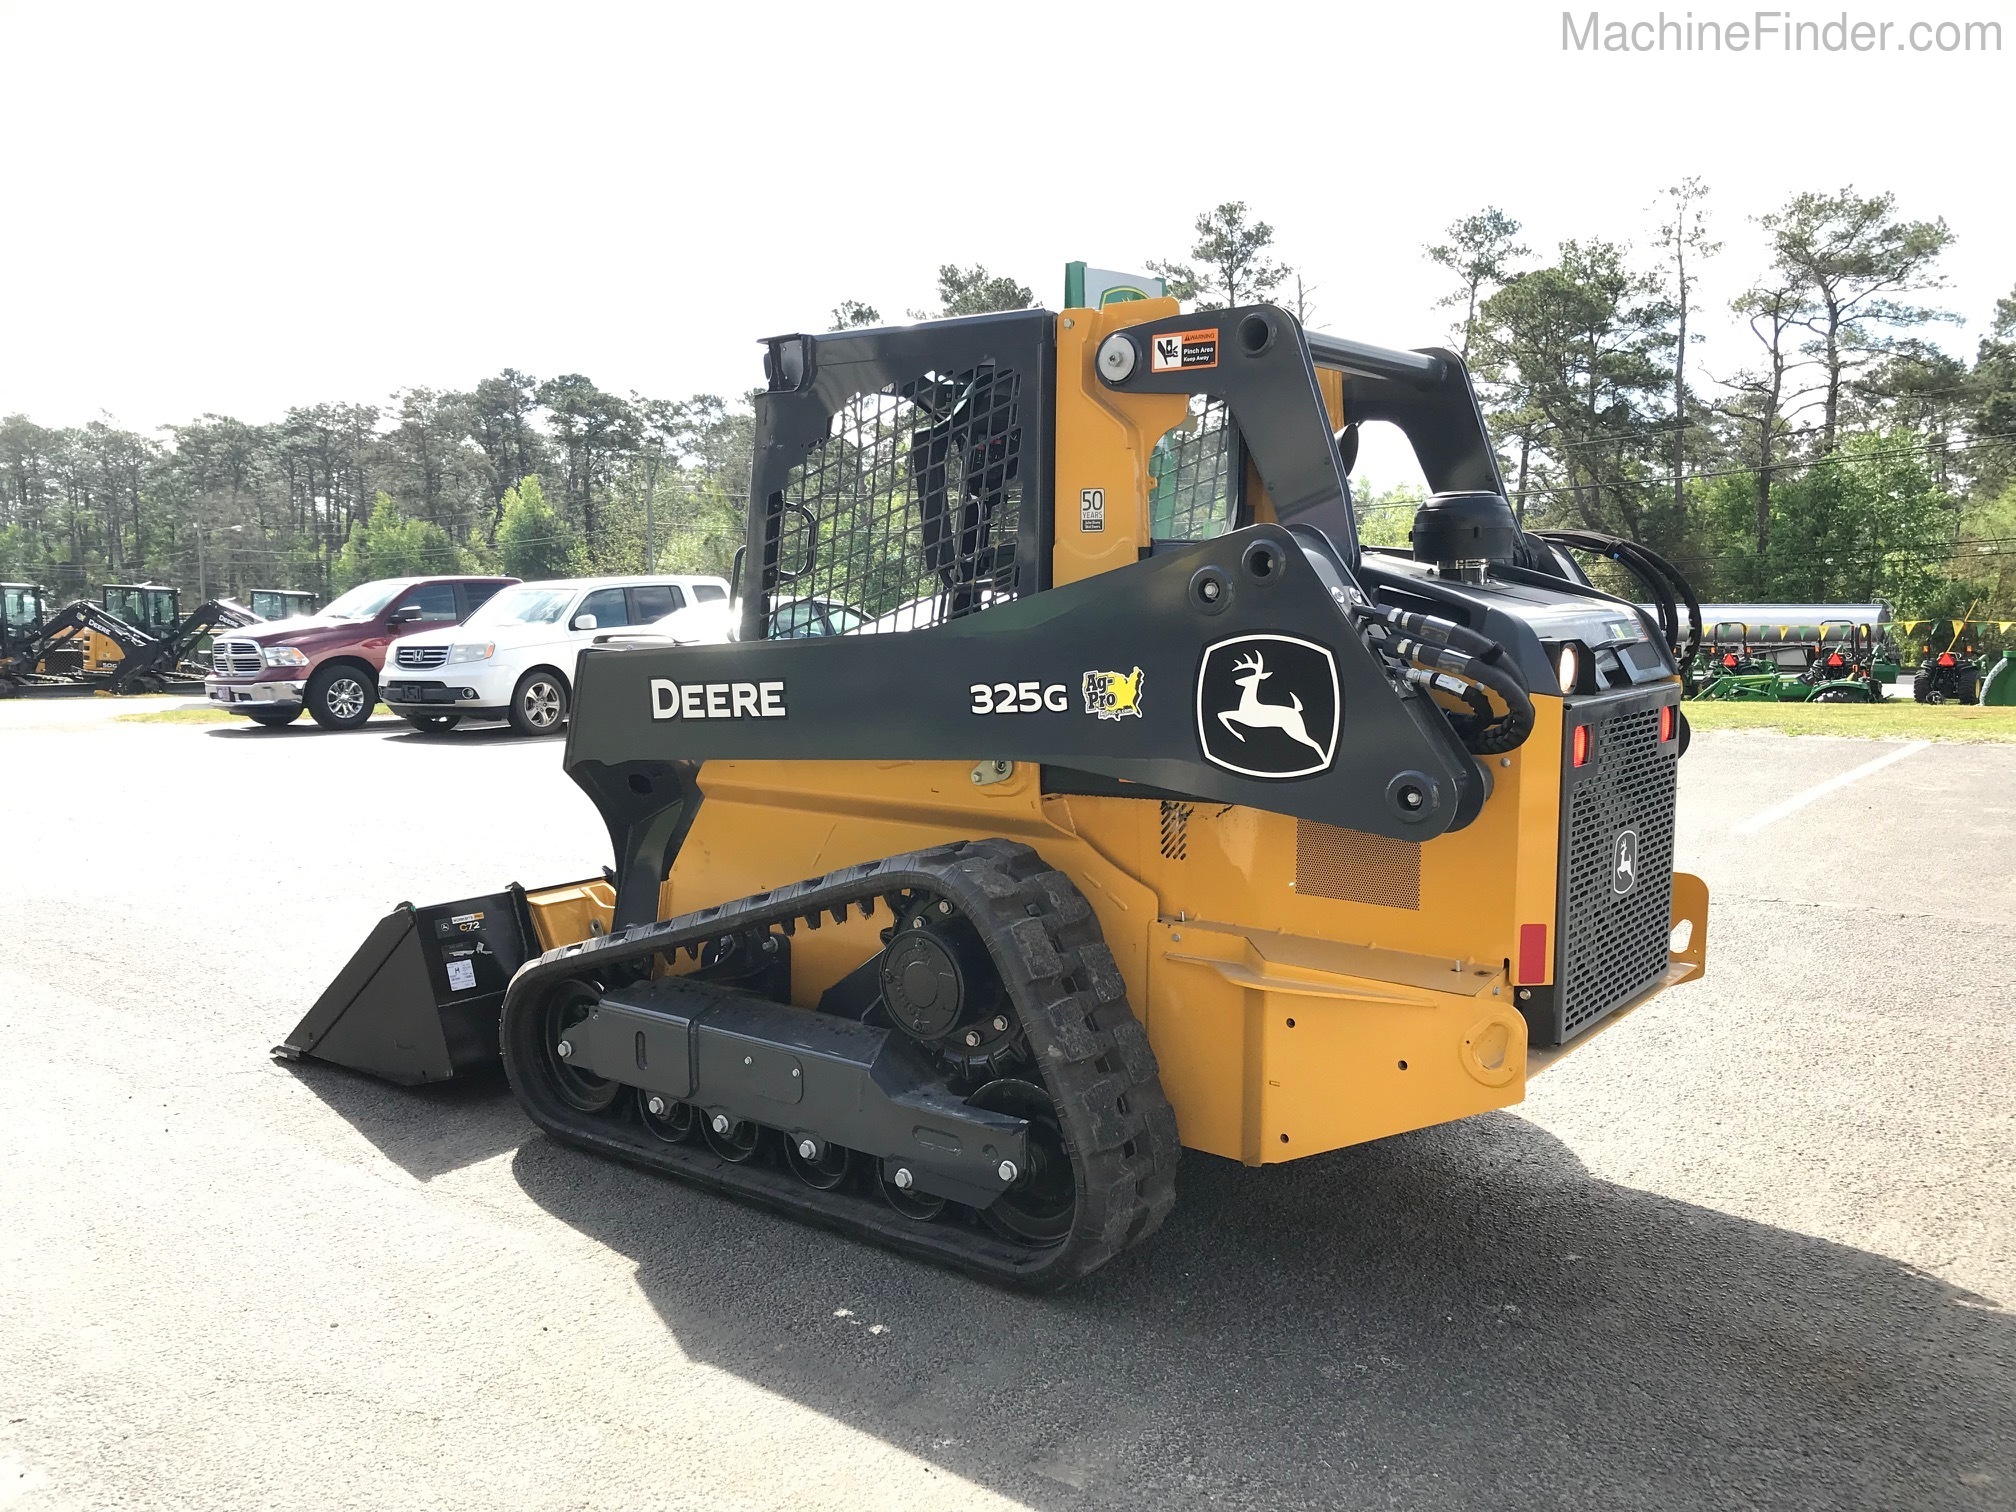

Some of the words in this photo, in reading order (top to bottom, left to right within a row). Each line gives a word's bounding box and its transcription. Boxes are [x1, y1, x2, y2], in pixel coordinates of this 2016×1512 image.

[1082, 490, 1103, 511] 50
[88, 618, 112, 635] DEERE
[218, 614, 239, 628] DEERE
[1086, 673, 1114, 694] Ag-
[650, 678, 786, 719] DEERE
[970, 681, 1068, 715] 325G
[1087, 692, 1117, 710] Pro
[459, 921, 480, 931] C72
